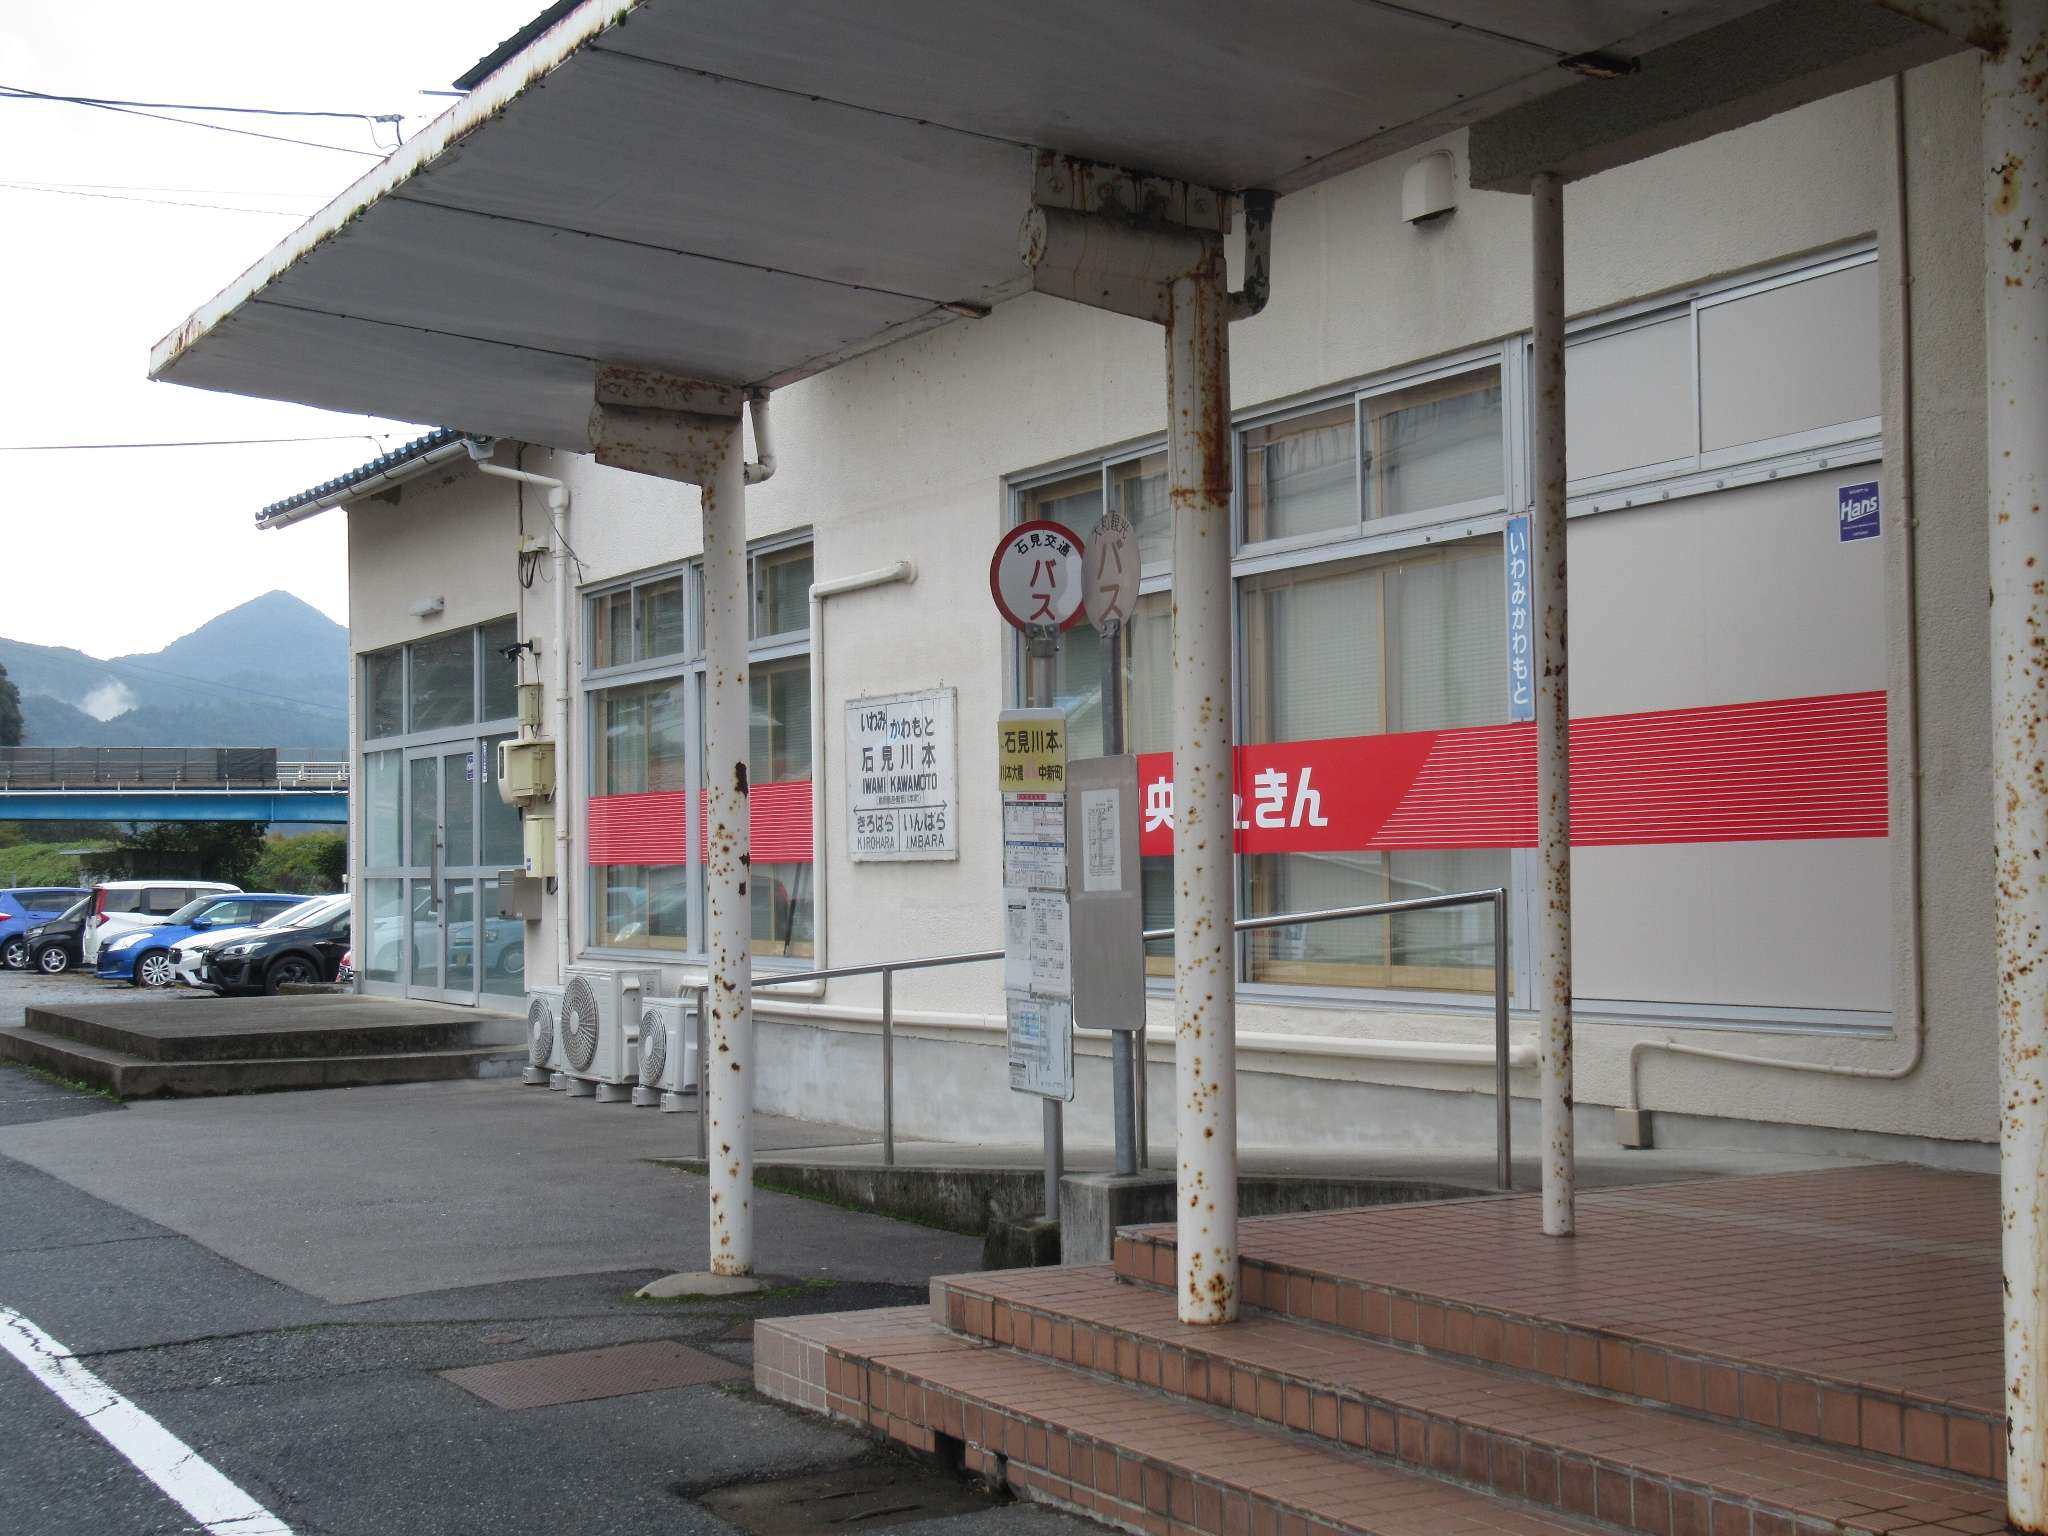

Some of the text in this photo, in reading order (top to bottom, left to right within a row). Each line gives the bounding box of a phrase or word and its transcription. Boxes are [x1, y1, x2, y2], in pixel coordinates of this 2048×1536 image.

[1841, 496, 1878, 523] Hans
[1014, 533, 1072, 558] 石見交通
[1030, 559, 1057, 621] バス
[1097, 541, 1123, 622] バス
[1510, 532, 1528, 705] いわみかわもと
[861, 711, 936, 739] いわみ かわもと
[1005, 730, 1059, 754] 石見川本
[862, 742, 936, 773] 石見川本
[863, 773, 938, 795] IWAMI KAWAMOTO
[1039, 764, 1063, 782] 中新町
[857, 815, 894, 834] きろはら
[903, 812, 946, 832] いんばら
[857, 834, 895, 850] KIROHARA
[906, 833, 945, 850] IMBARA
